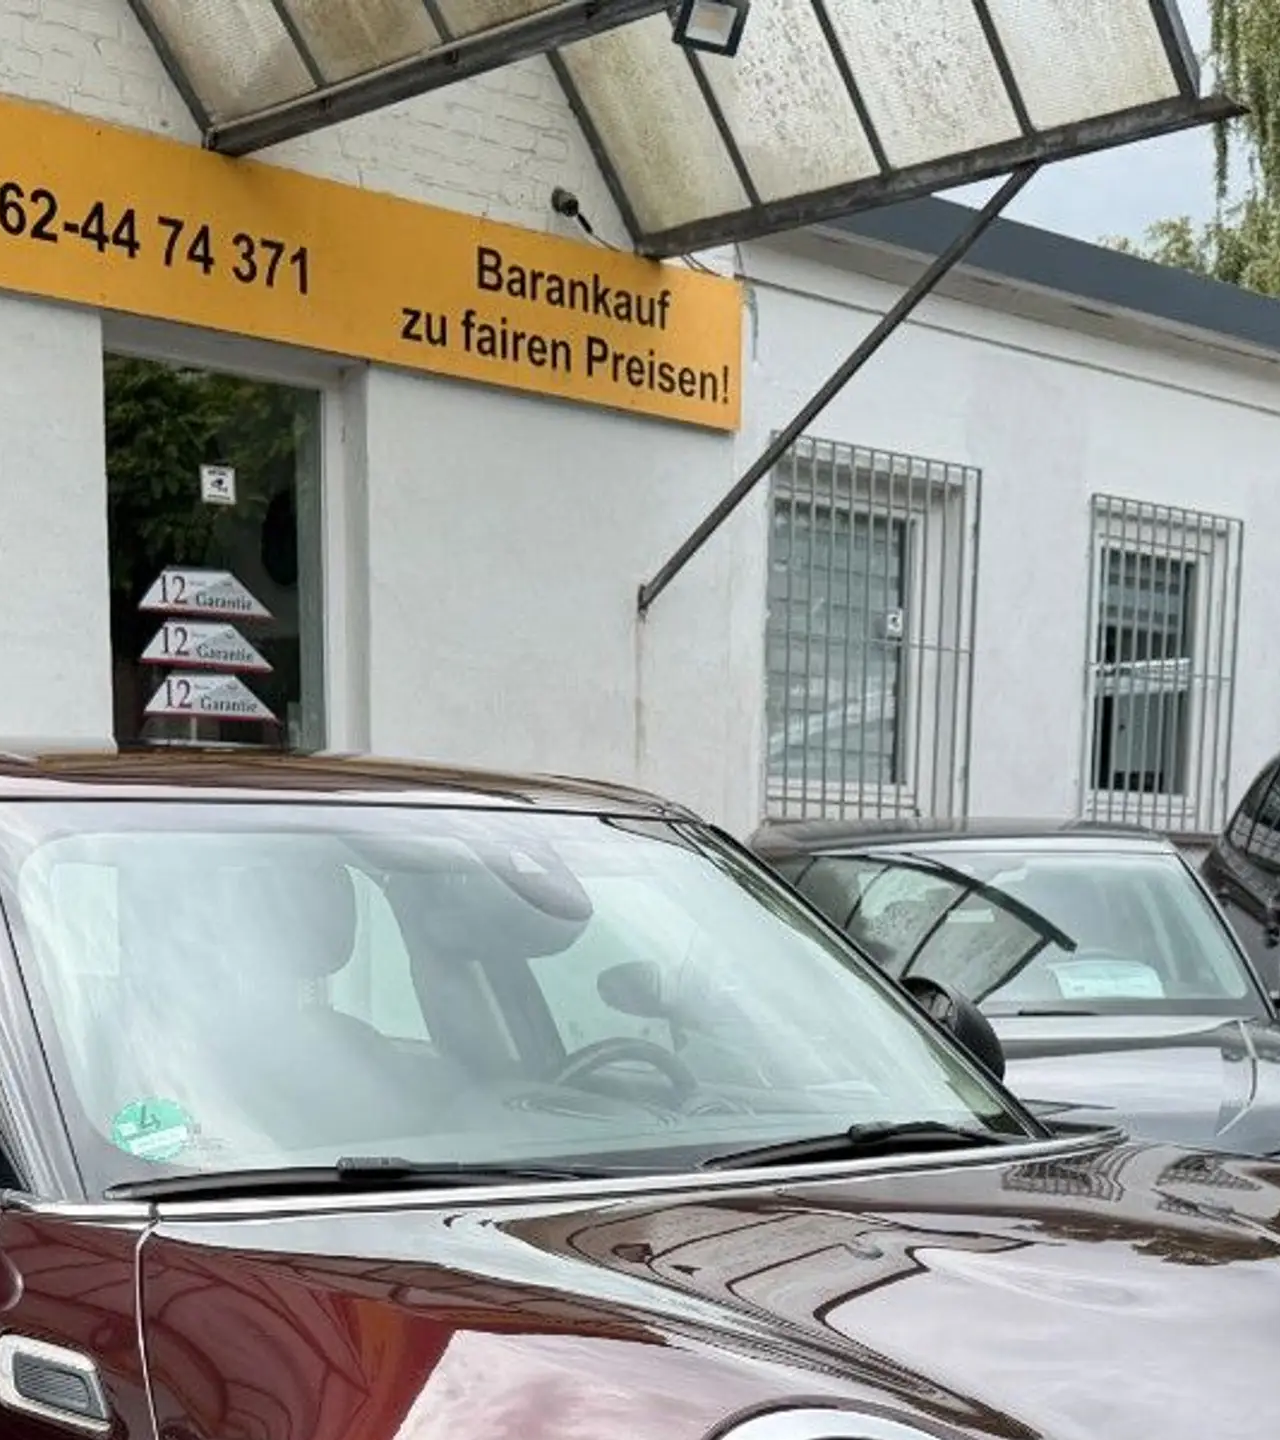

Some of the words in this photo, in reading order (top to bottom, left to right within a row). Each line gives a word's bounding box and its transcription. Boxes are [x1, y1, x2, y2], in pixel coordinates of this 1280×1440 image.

[157, 215, 215, 276] 74
[231, 232, 309, 295] 371
[476, 245, 672, 331] Barankauf
[400, 306, 448, 347] zu
[460, 309, 572, 373] fairen
[586, 335, 729, 404] Preisen!
[160, 574, 188, 604] 12
[195, 591, 253, 611] Garantie
[161, 626, 190, 656] 12
[197, 643, 254, 661] Garantie
[165, 679, 192, 709] 12
[200, 696, 258, 713] Garantie
